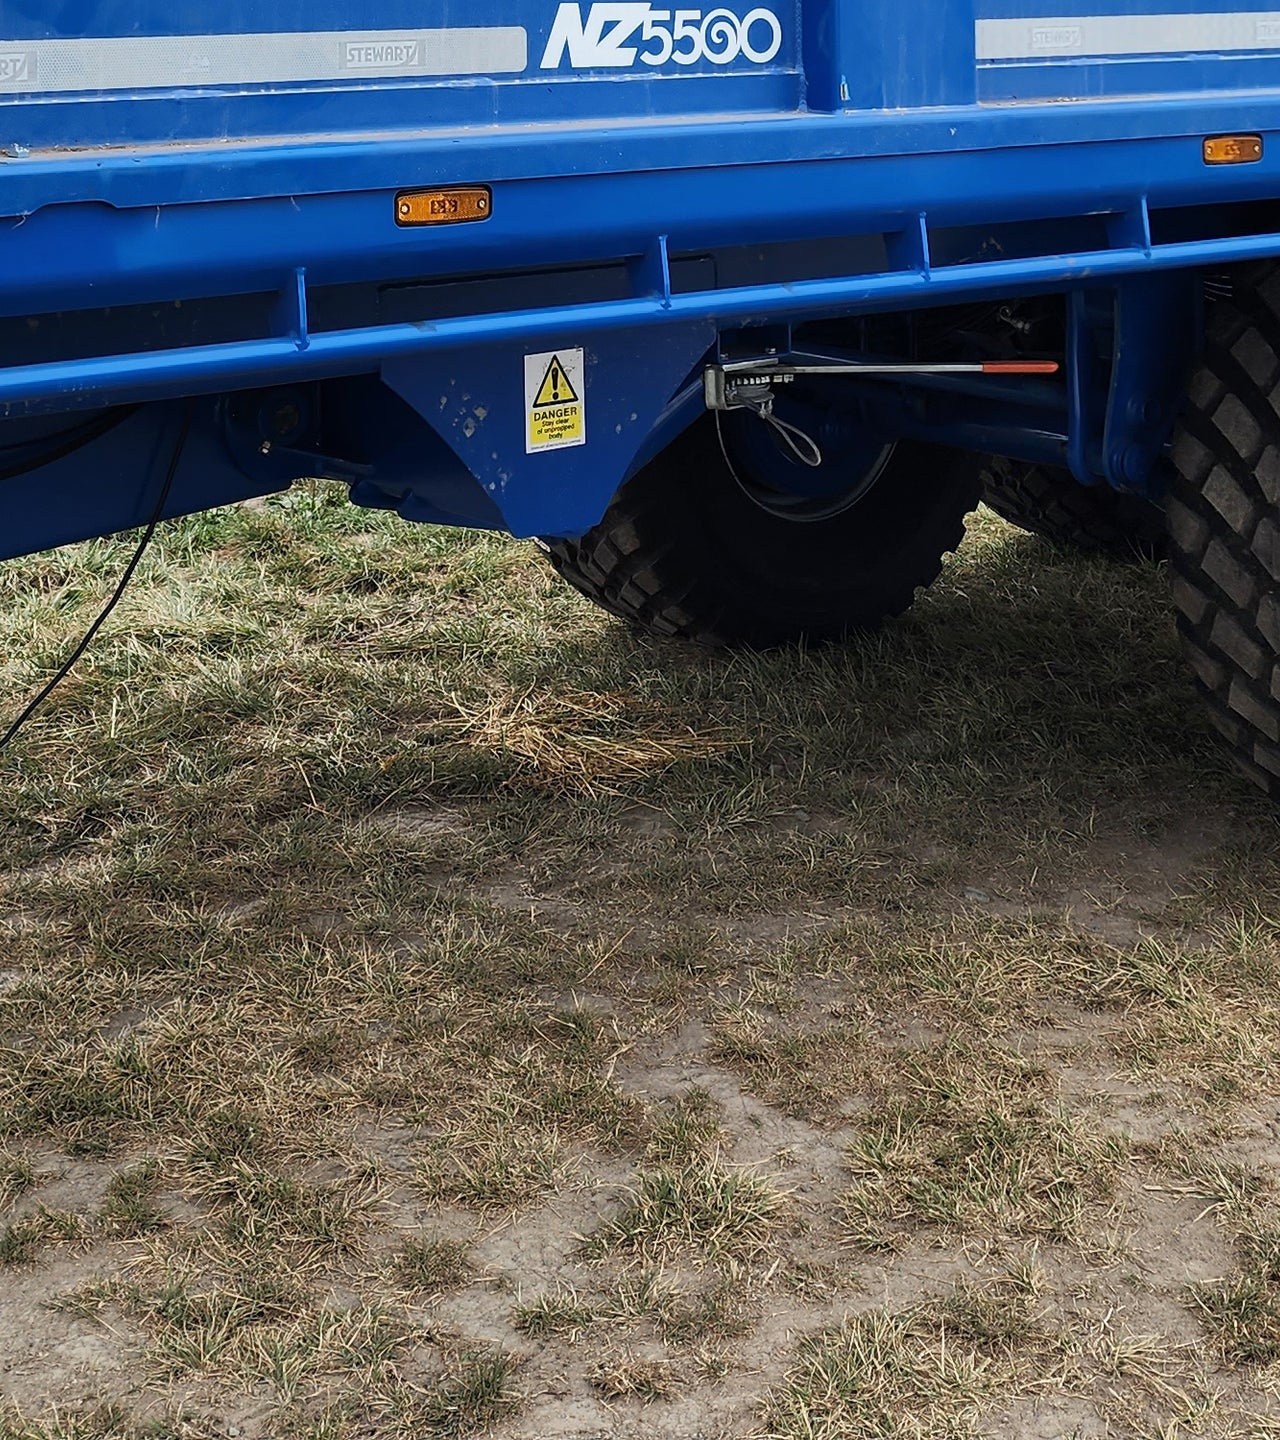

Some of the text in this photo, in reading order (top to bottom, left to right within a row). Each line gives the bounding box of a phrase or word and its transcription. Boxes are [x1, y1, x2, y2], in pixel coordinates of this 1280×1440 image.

[540, 3, 782, 68] NZ5500
[348, 45, 418, 67] STEWART
[534, 407, 577, 422] DANGER
